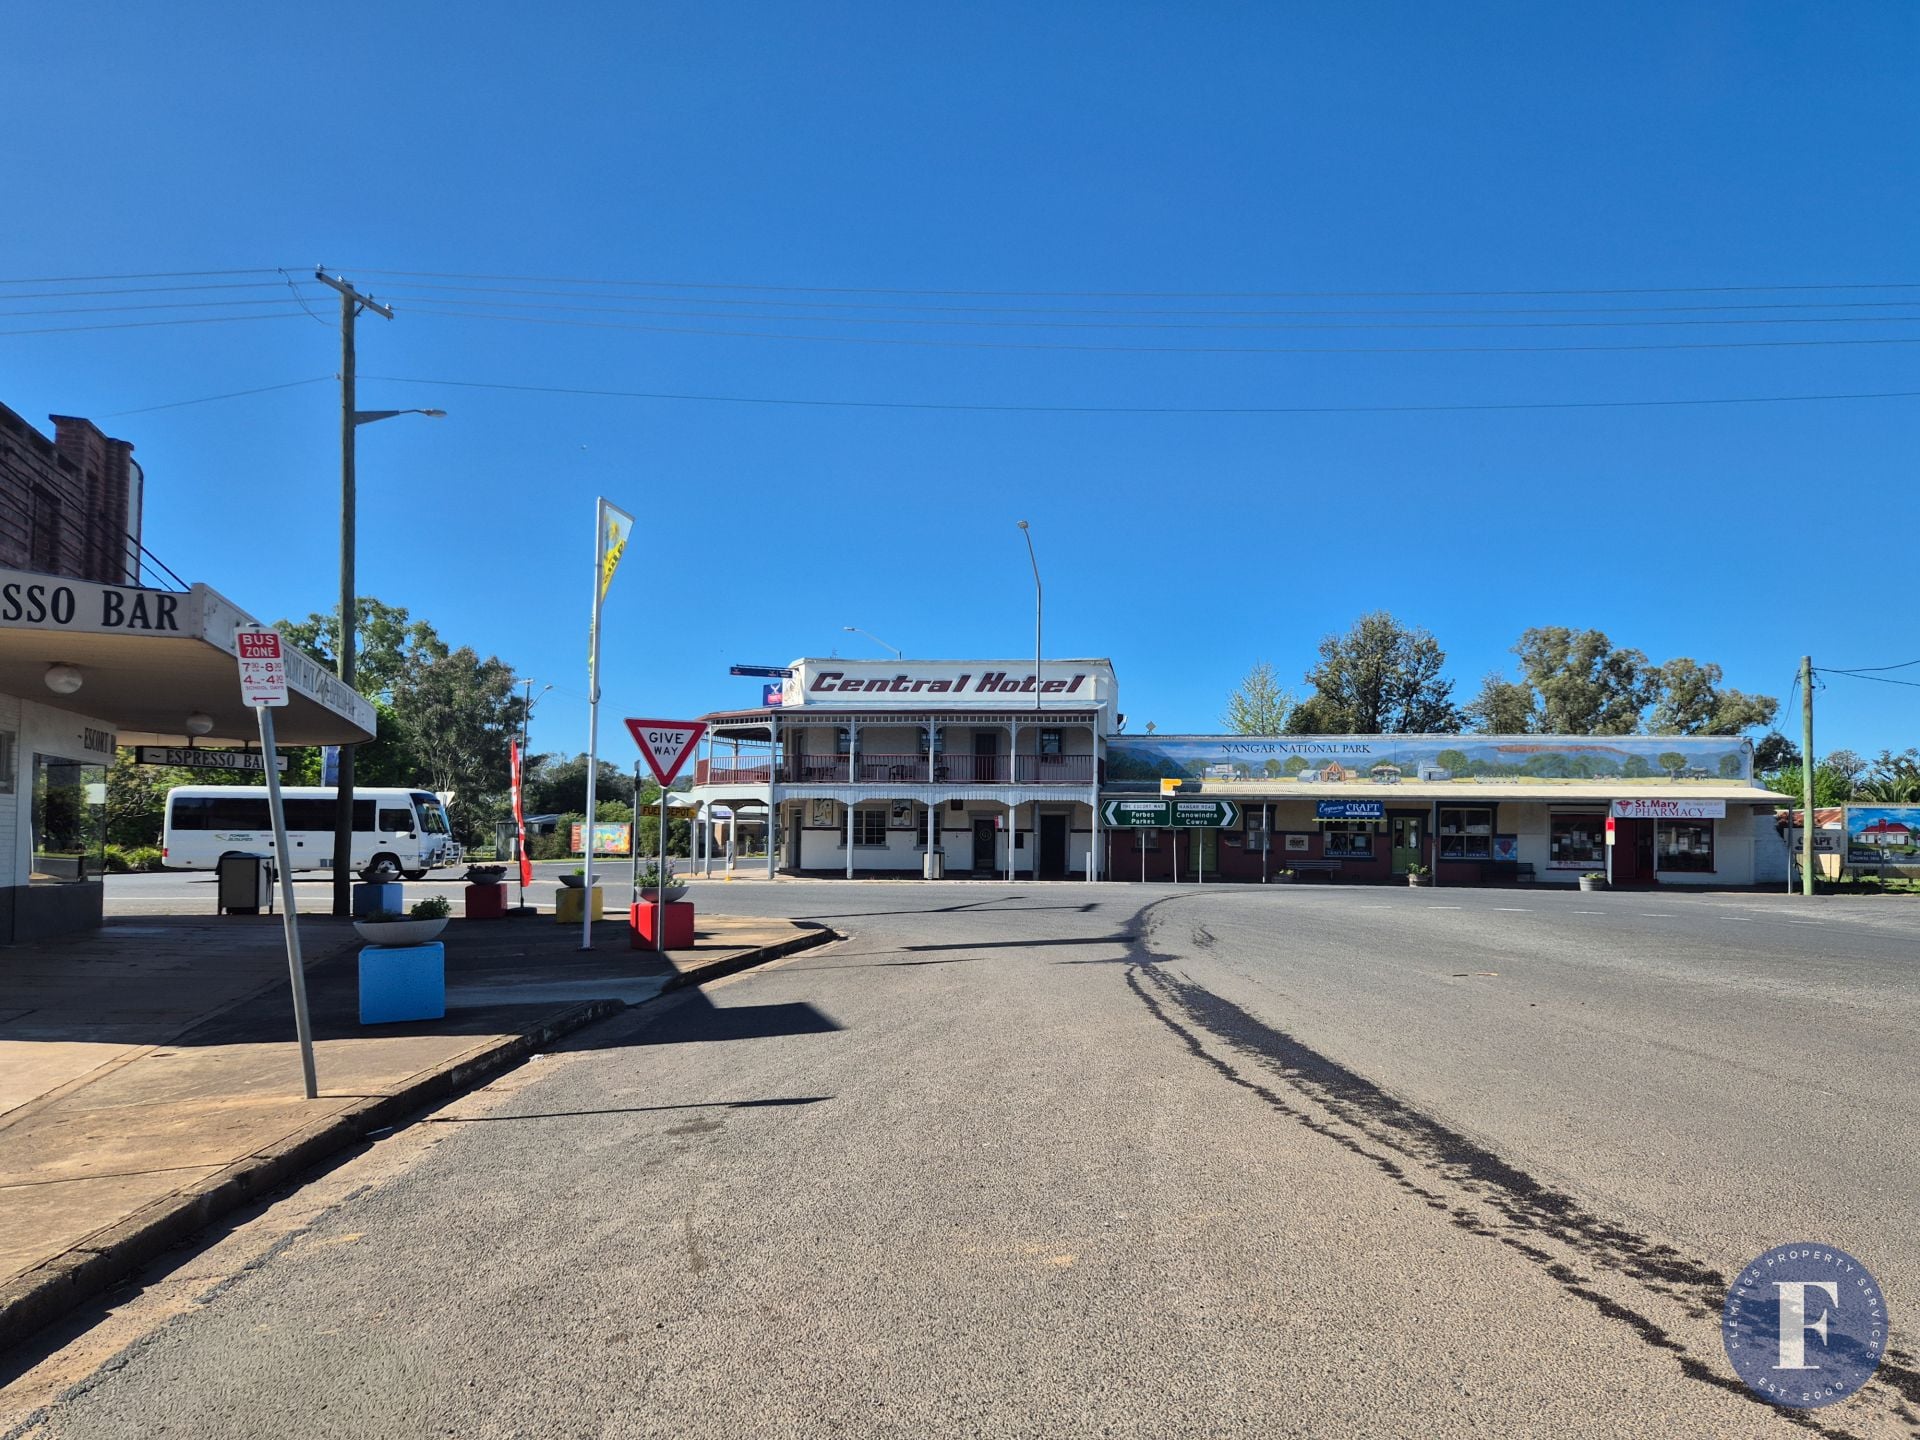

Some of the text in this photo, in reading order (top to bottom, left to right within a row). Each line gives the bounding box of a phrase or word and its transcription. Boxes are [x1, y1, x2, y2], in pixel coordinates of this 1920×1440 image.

[101, 590, 179, 630] BAR
[242, 634, 274, 645] BUS
[245, 647, 275, 657] ZONE
[809, 672, 1086, 693] Central Hotel
[84, 727, 109, 753] ESCORT
[649, 732, 684, 744] GIVE
[654, 746, 678, 756] WAY
[1222, 744, 1371, 753] NANGAR NATIONAL PARK
[166, 750, 235, 767] ESPRESSO
[1346, 803, 1380, 811] CRAFT
[1635, 808, 1705, 817] PHARMACY
